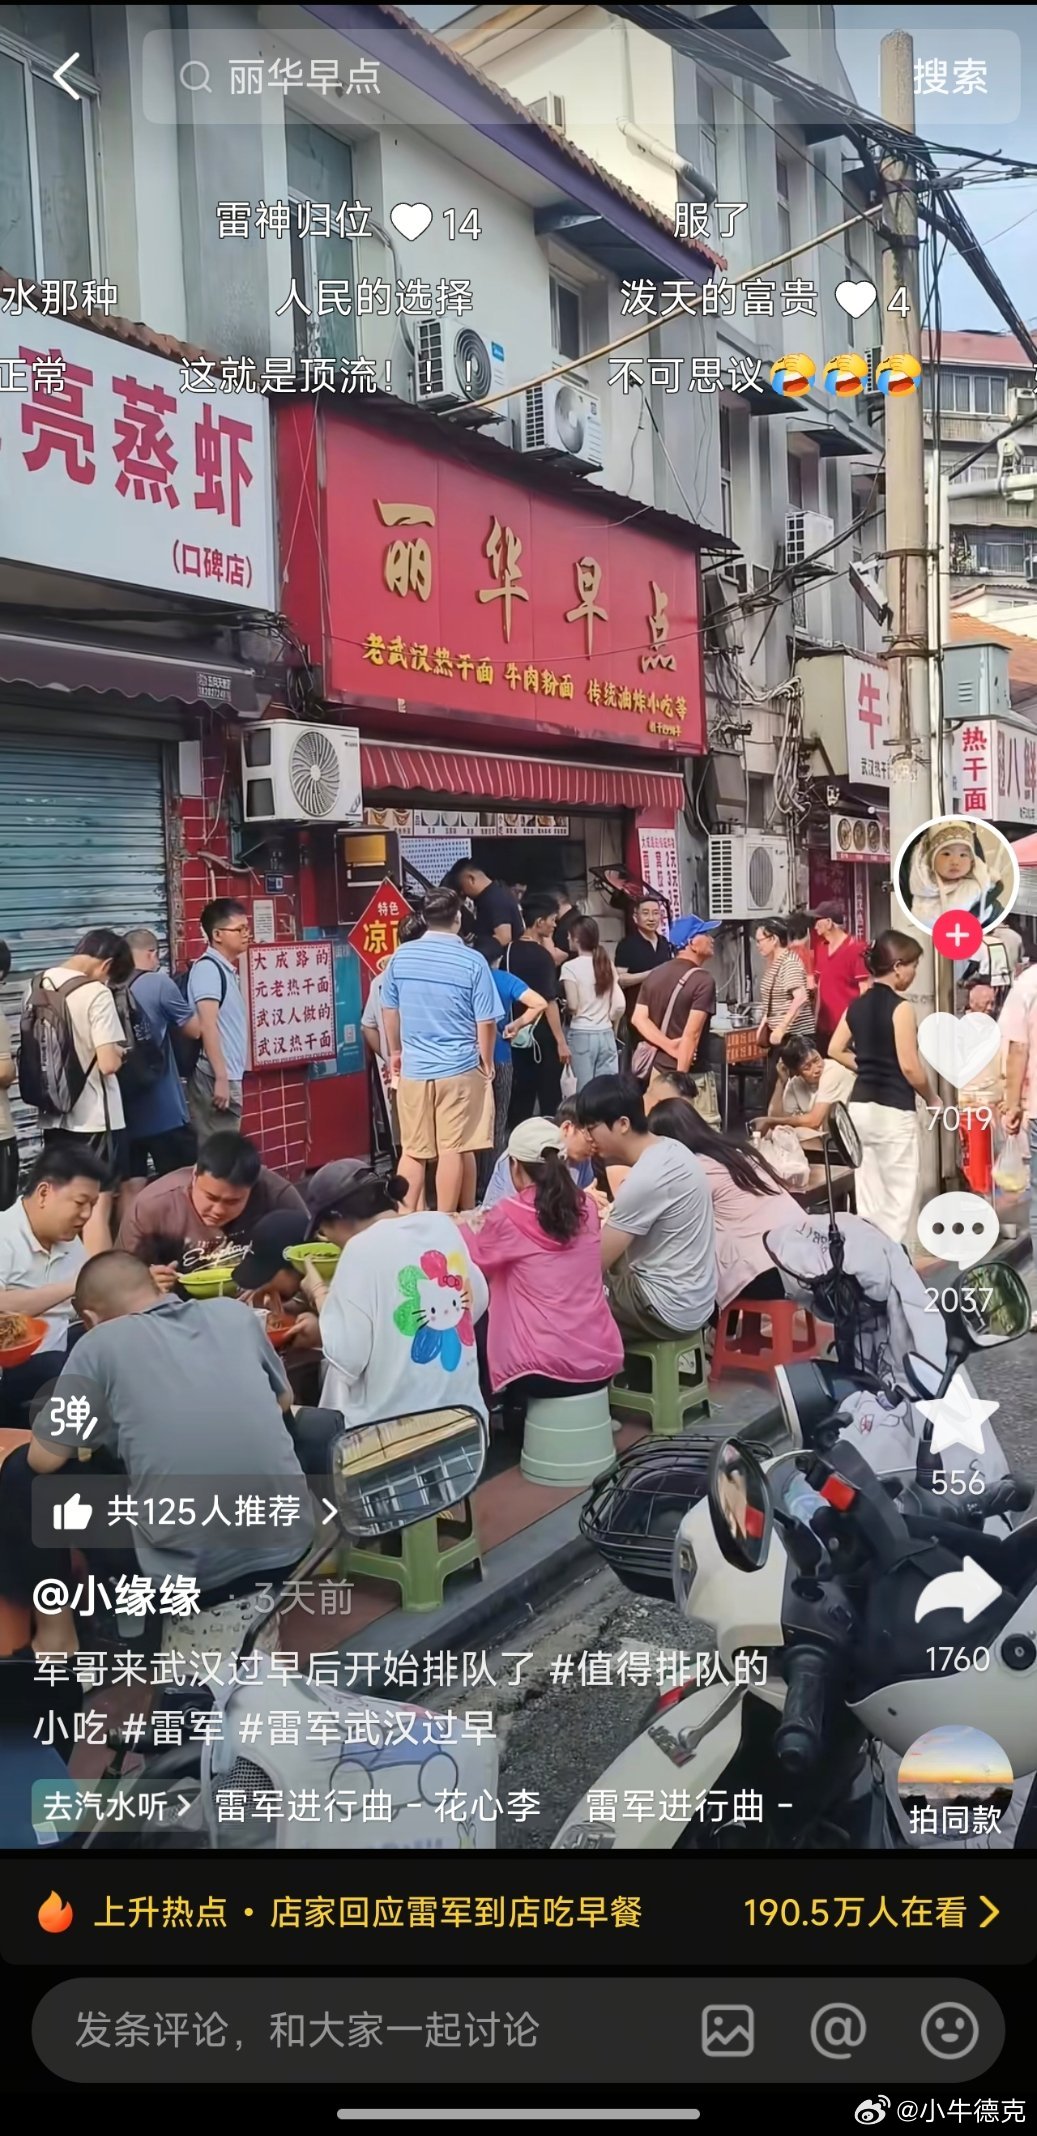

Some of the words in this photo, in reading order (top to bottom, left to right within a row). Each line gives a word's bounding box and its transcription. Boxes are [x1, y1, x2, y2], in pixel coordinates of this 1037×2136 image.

[172, 539, 254, 588] (口碑店)
[374, 499, 677, 673] 丽华早点
[362, 632, 494, 685] 老武汉热干面
[504, 662, 575, 700] 牛肉粉面
[586, 678, 688, 720] 传统油炸小吃等
[861, 757, 893, 780] 武汉热干
[962, 726, 987, 812] 热干面
[377, 901, 400, 917] 特色
[253, 949, 328, 970] 大成路的
[255, 975, 330, 998] 元老热干面
[256, 1005, 331, 1028] 武汉人做的
[257, 1030, 332, 1058] 武汉热干面
